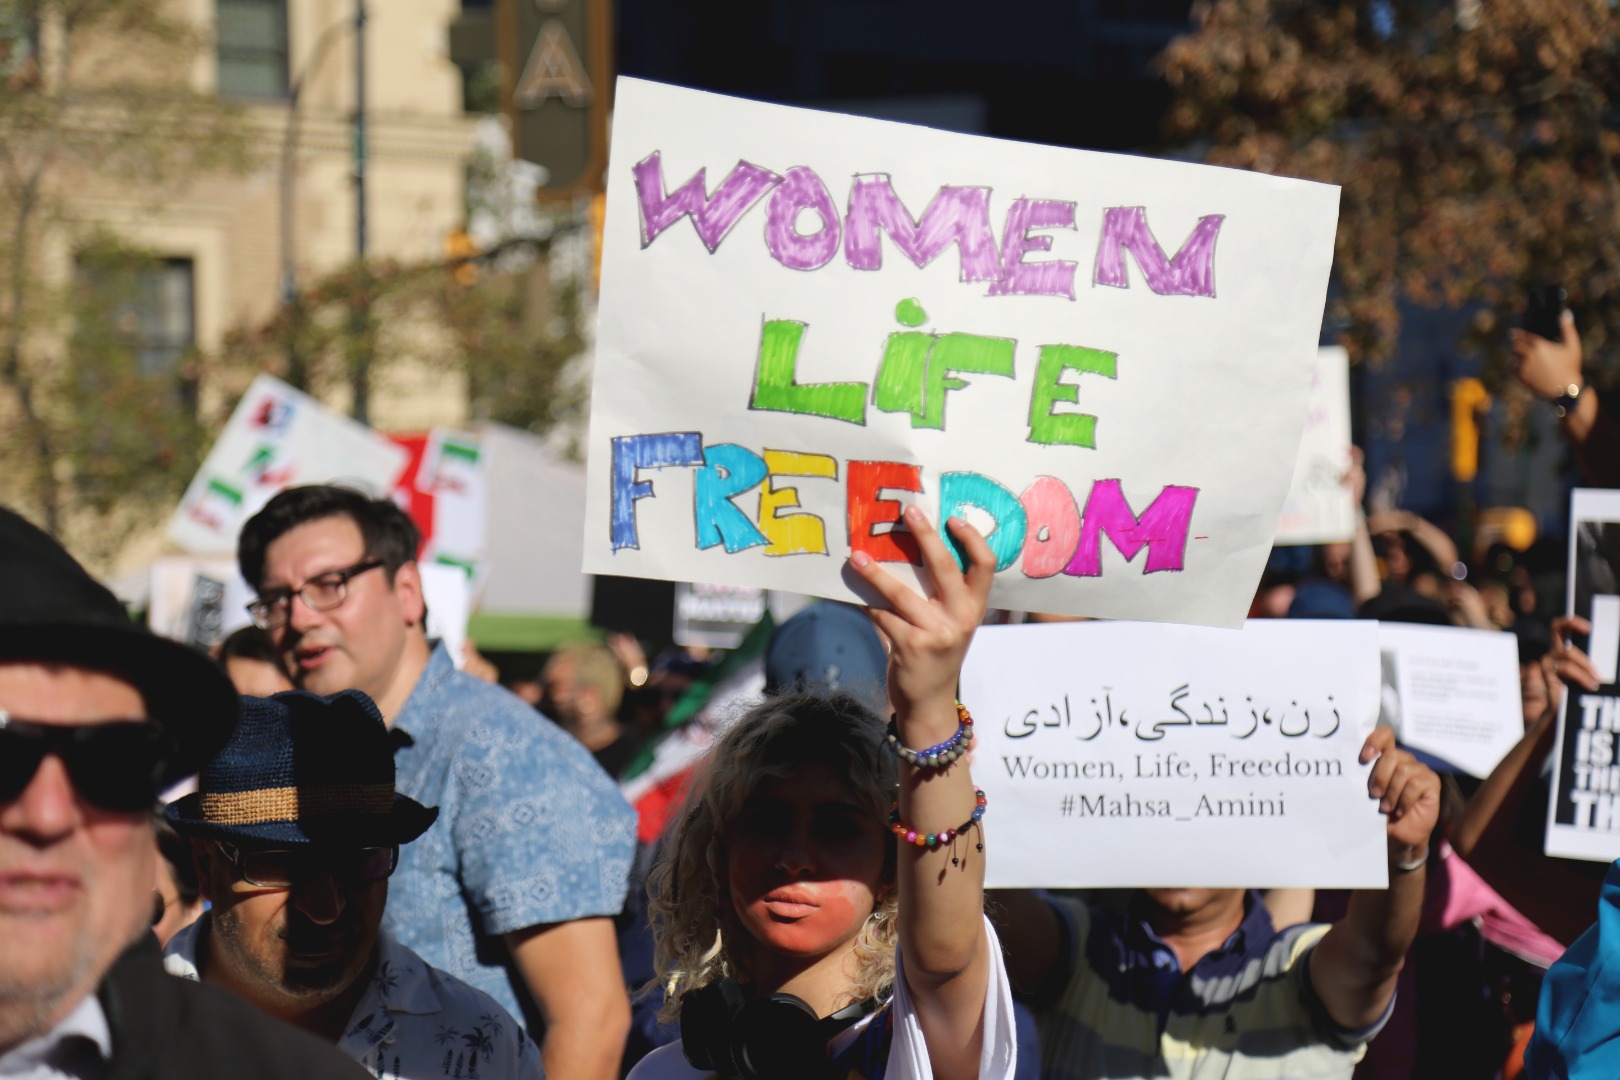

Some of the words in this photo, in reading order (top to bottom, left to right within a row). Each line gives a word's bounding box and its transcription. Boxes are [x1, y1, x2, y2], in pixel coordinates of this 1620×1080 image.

[633, 150, 1227, 299] WOMEN
[610, 431, 1200, 579] FREEDOM
[1002, 756, 1124, 782] Women,
[1135, 753, 1198, 782] Life,
[1209, 752, 1343, 777] Freedom
[1577, 729, 1614, 767] IS
[1060, 792, 1285, 821] #Mahsa_Amini
